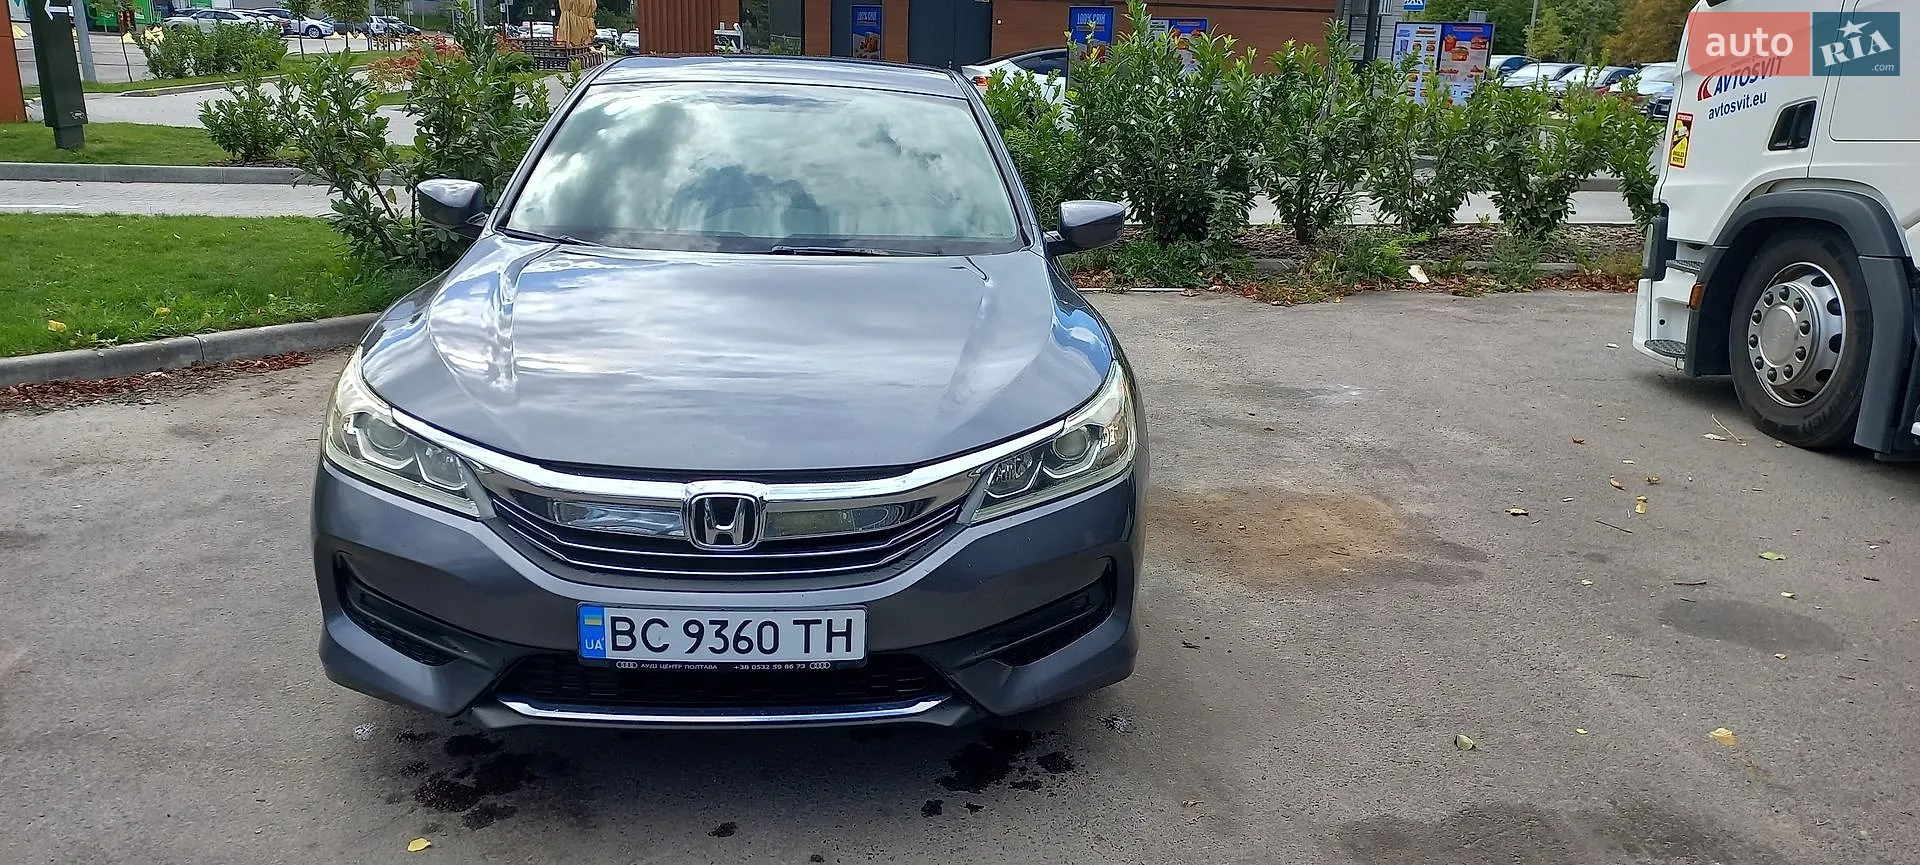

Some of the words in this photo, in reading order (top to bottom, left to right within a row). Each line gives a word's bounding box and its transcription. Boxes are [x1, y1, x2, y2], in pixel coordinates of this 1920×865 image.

[1713, 56, 1786, 96] AVTOSVIT
[1708, 91, 1767, 119] avtosvit.eu
[585, 639, 604, 650] UA
[610, 616, 670, 653] BC
[682, 619, 780, 655] 9360
[793, 618, 853, 654] TH
